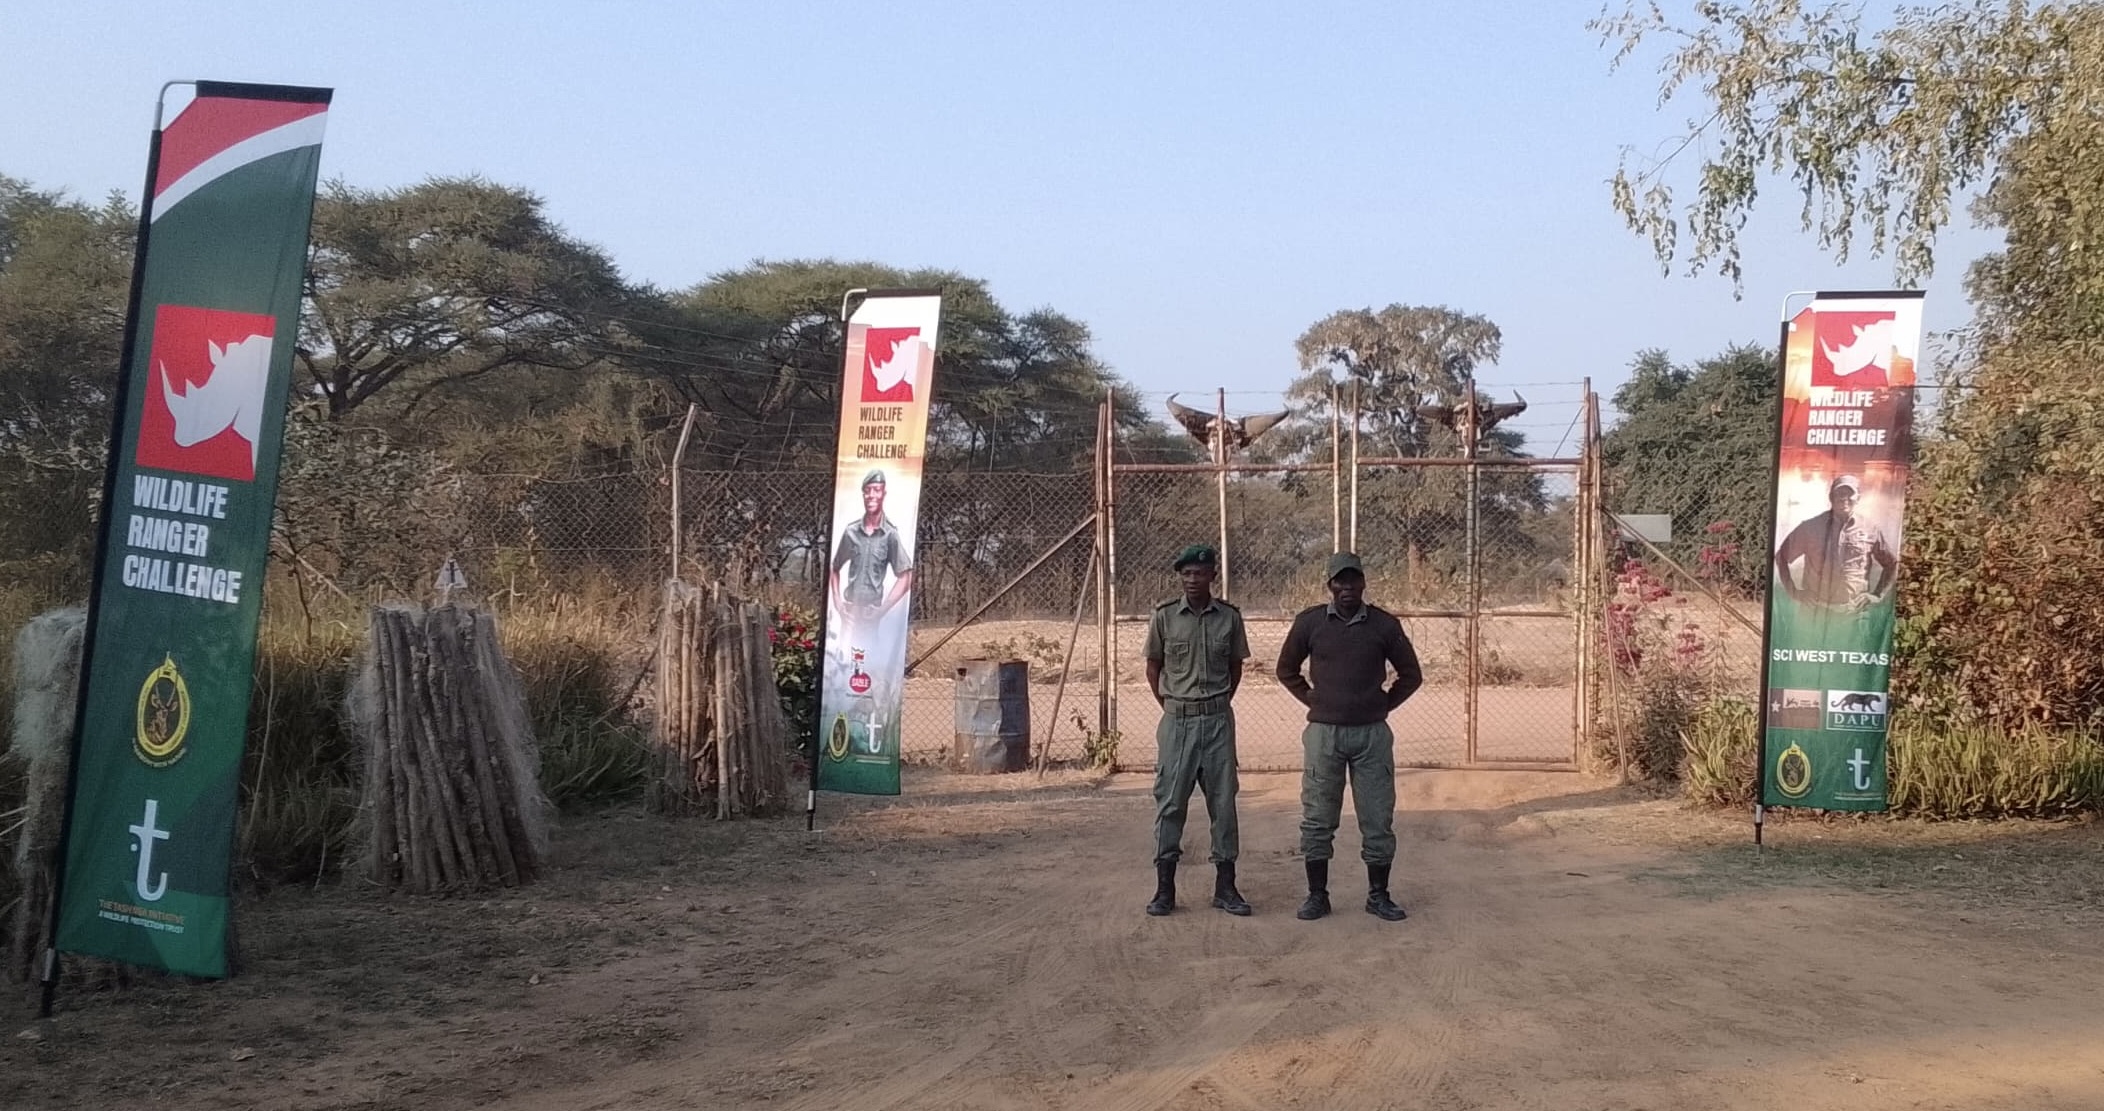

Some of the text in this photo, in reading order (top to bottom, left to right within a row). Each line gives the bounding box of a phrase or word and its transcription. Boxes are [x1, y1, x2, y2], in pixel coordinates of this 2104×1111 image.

[1809, 390, 1874, 407] WILDLIFE
[860, 407, 903, 422] WILDLIFE
[1808, 410, 1863, 426] RANGER
[858, 425, 895, 440] RANGER
[1806, 428, 1886, 445] CHALLENGE
[856, 443, 908, 459] CHALLENGE
[133, 474, 229, 519] WILDLIFE
[127, 515, 209, 557] RANGER
[122, 554, 242, 604] CHALLENGE
[1773, 648, 1889, 666] SCI WEST TEXAS
[1834, 713, 1880, 726] DAPU
